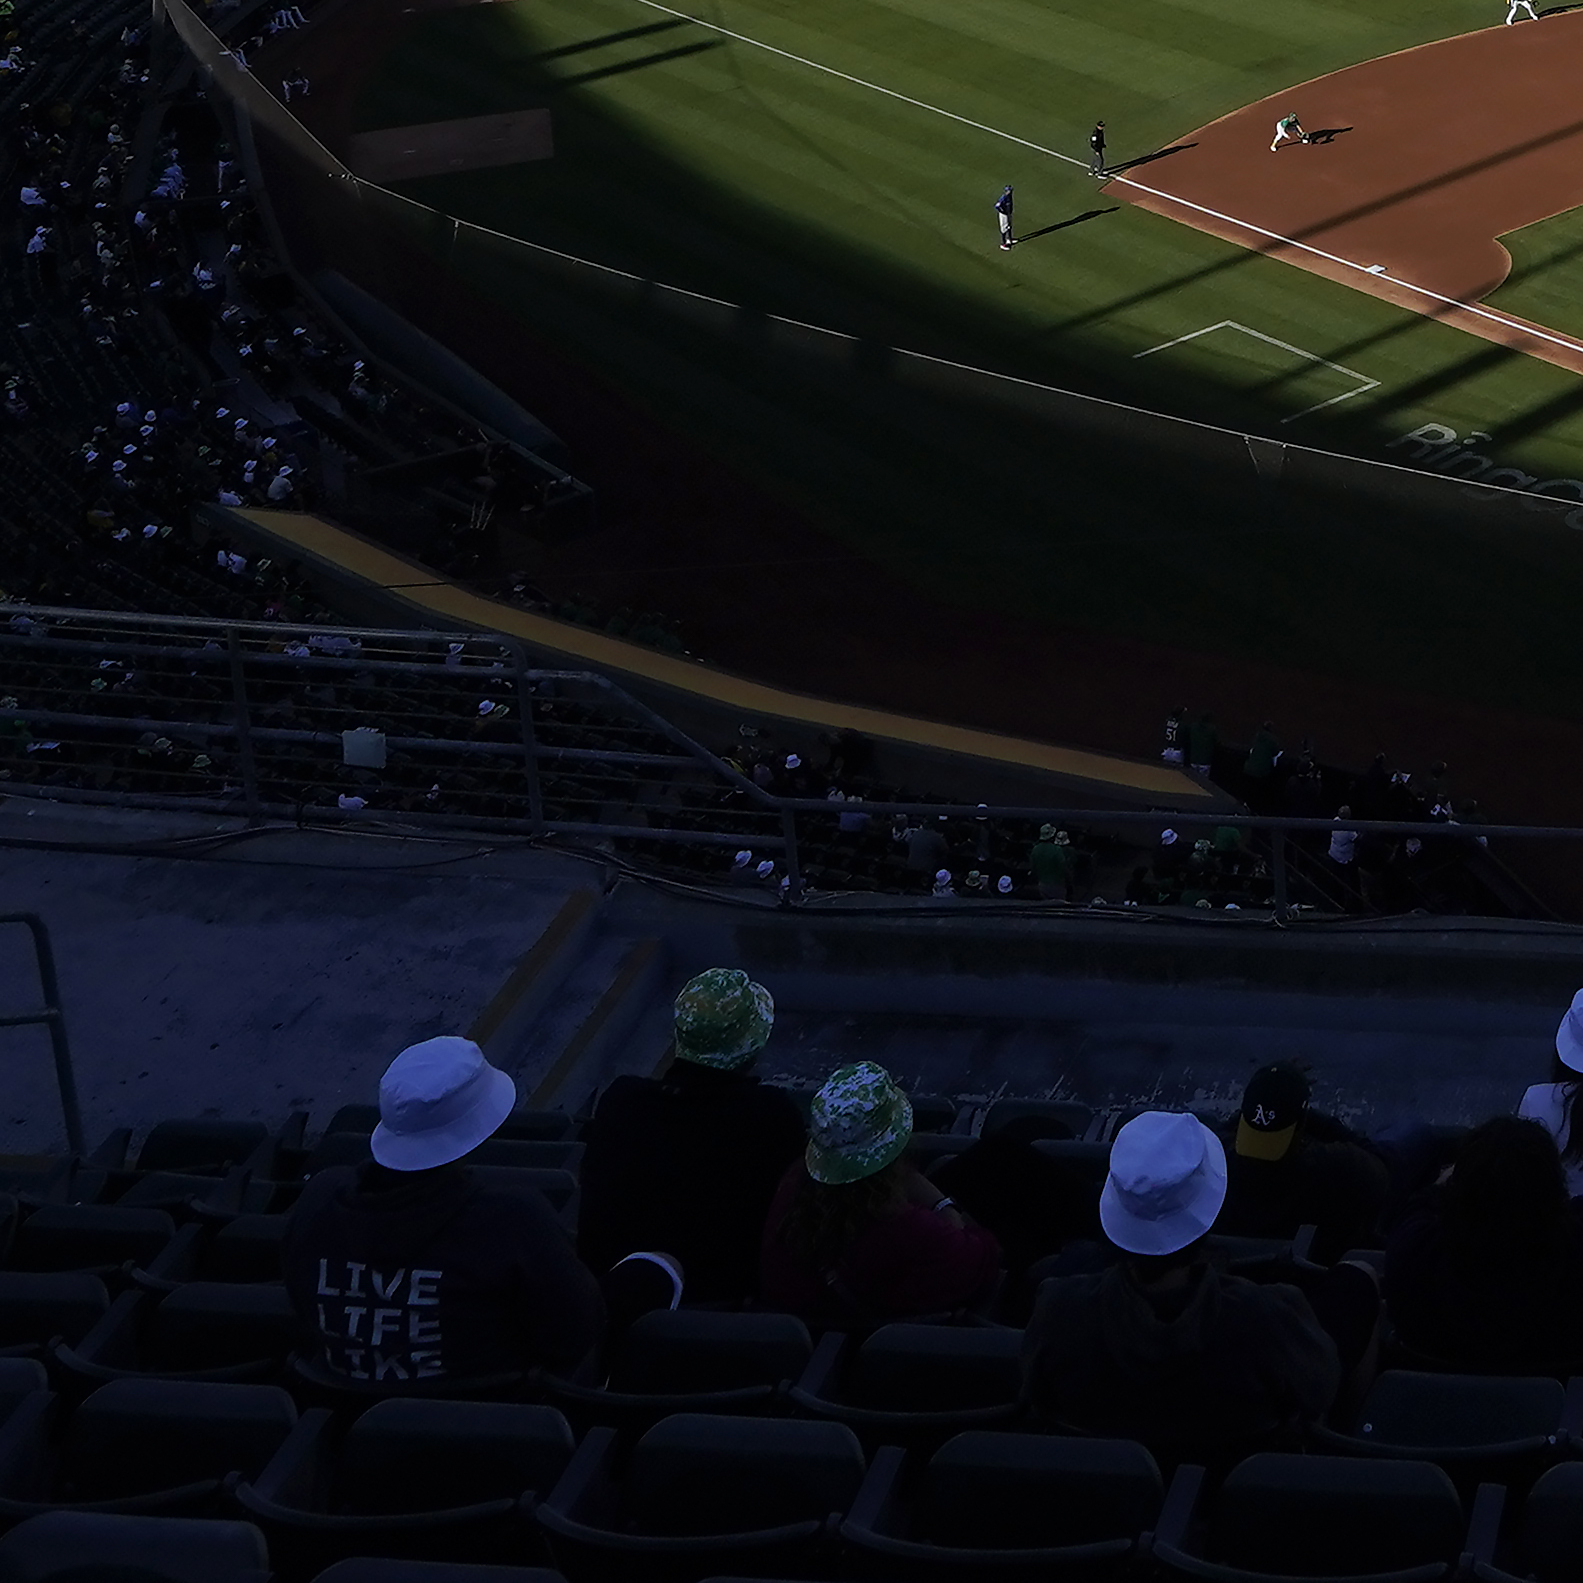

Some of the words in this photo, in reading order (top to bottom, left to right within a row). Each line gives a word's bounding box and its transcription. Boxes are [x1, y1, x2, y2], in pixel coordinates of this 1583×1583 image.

[317, 1258, 443, 1305] LIVE
[317, 1304, 442, 1345] LIFE
[325, 1345, 447, 1380] LIKE
